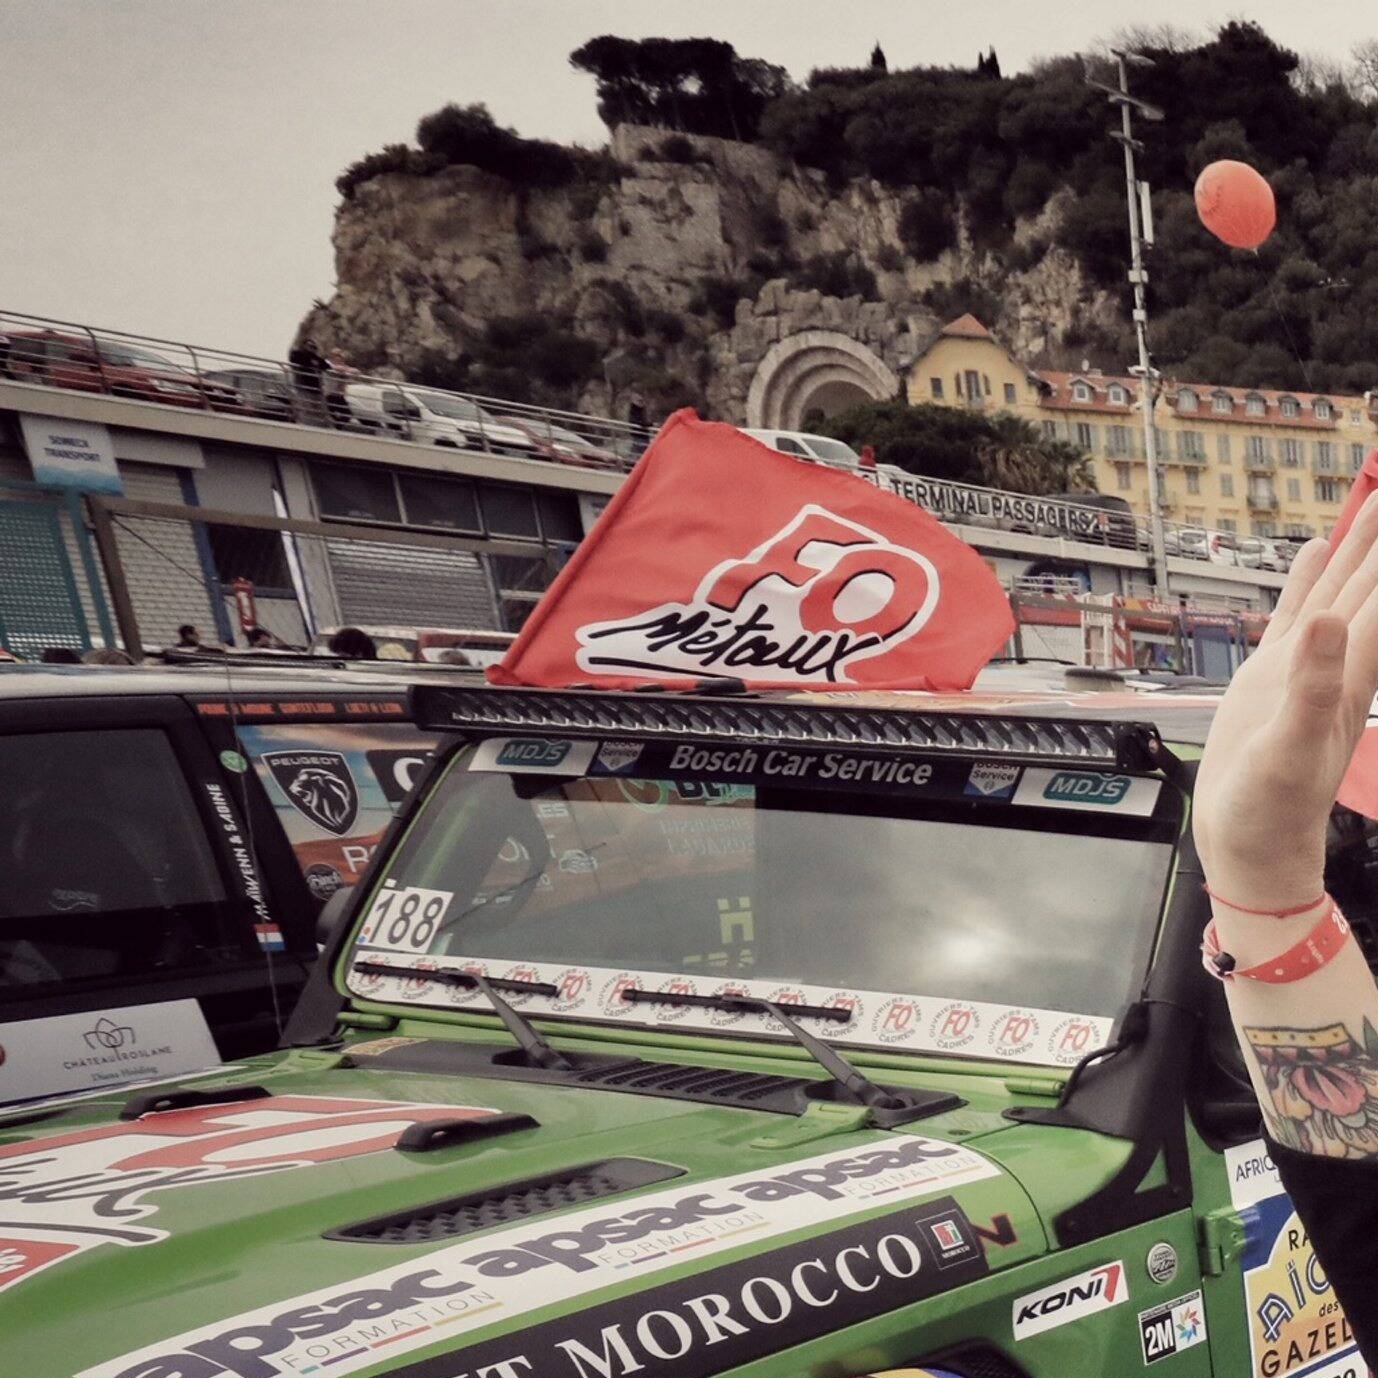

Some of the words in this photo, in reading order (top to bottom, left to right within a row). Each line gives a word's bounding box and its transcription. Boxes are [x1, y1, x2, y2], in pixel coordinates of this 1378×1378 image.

[889, 478, 988, 516] TERMINAL
[703, 513, 930, 640] FO
[589, 605, 887, 683] Métaux
[270, 756, 340, 767] PEUGEOT
[503, 741, 564, 762] MDJS
[669, 743, 758, 775] Bosch
[763, 750, 803, 779] Car
[806, 753, 933, 786] Service
[206, 783, 239, 832] SABINE
[1049, 775, 1126, 799] MDJS
[369, 893, 444, 949] 188
[883, 1002, 911, 1031] FO
[940, 1008, 971, 1036] FO
[1001, 1015, 1031, 1044] FO
[1060, 1023, 1089, 1051] FO
[729, 1138, 958, 1202] apsac
[843, 1154, 978, 1197] FORMATION
[462, 1193, 749, 1278] apsac
[597, 1208, 767, 1266] FORMATION
[1017, 1269, 1112, 1326] KONI
[281, 1288, 496, 1370] FORMATION
[1145, 1319, 1174, 1357] 2M
